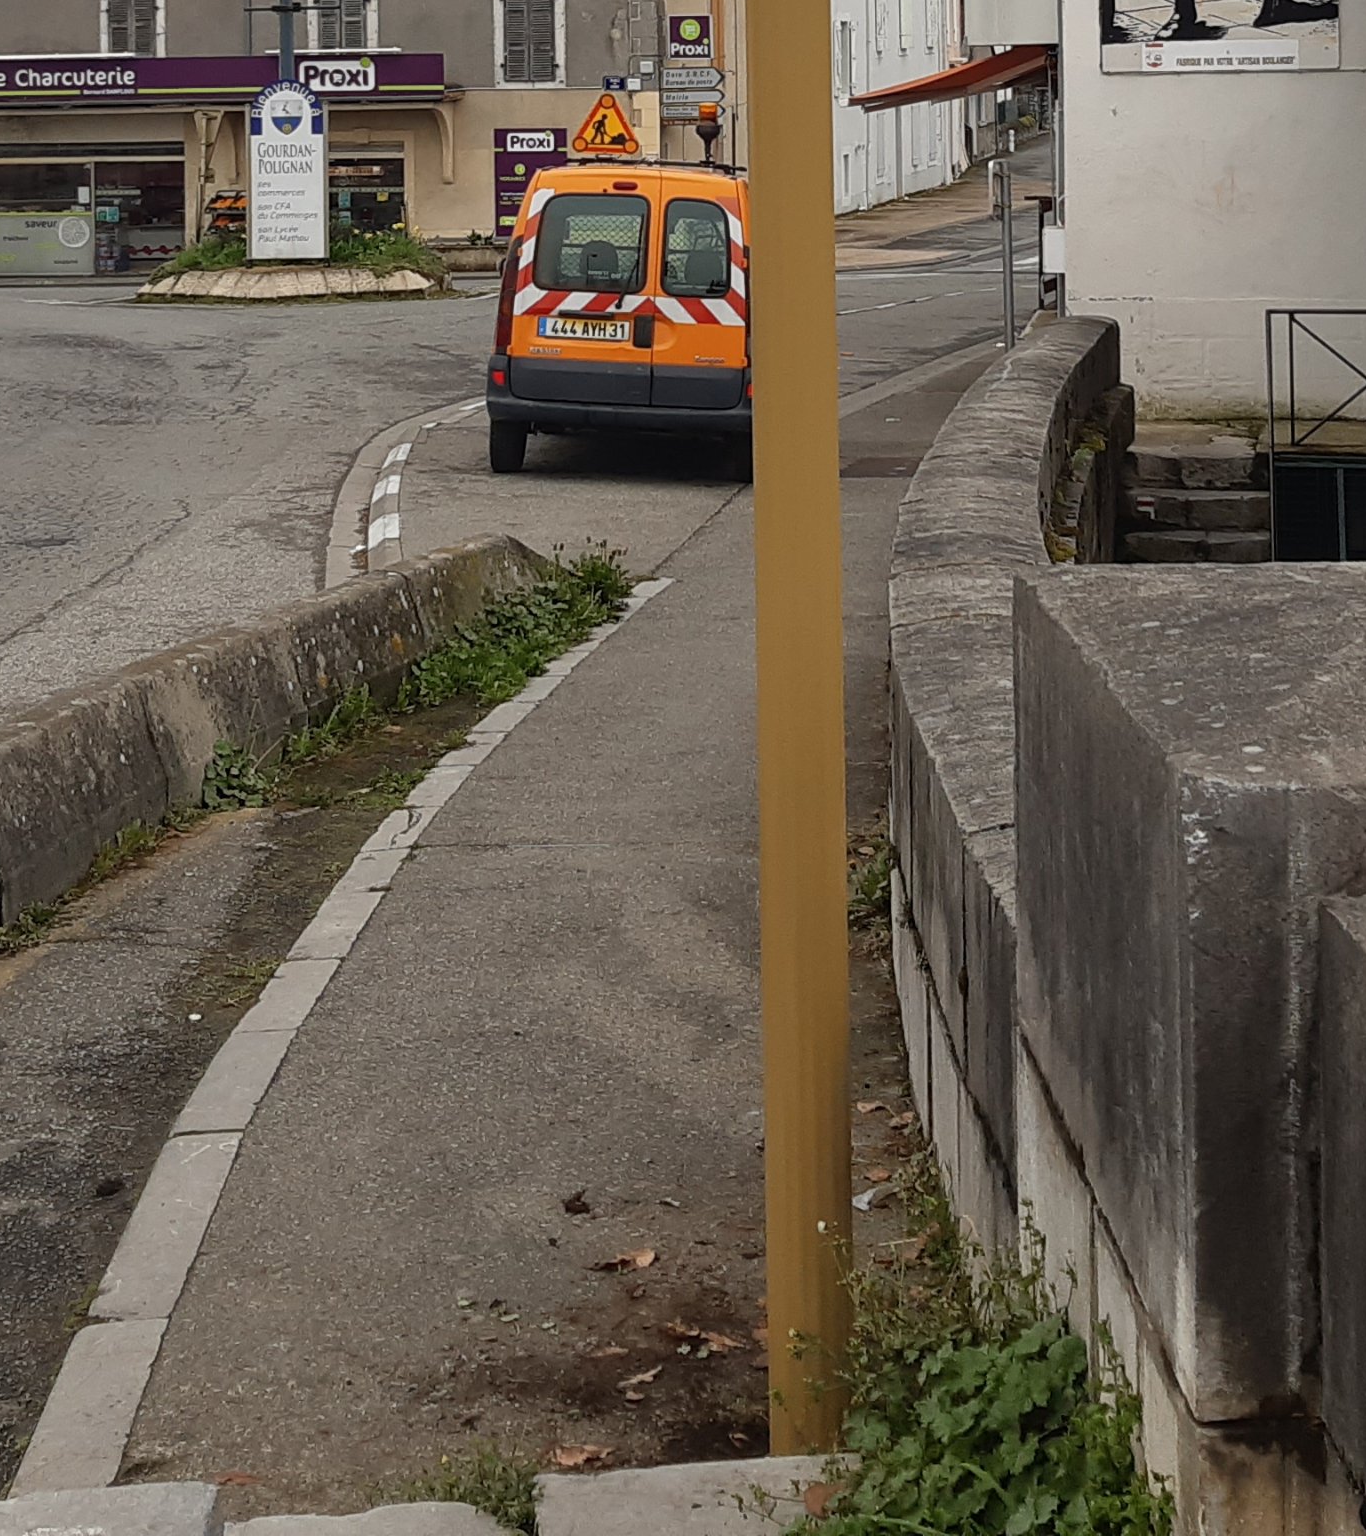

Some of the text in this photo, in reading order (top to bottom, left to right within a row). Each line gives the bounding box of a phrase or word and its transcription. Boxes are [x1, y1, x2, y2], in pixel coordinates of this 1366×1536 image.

[670, 37, 709, 56] Proxi
[14, 66, 136, 88] Charcuterie
[304, 57, 370, 87] Proxi
[251, 81, 316, 117] Bienvenue
[510, 131, 552, 149] Proxi
[257, 142, 317, 158] GOURDAN-
[258, 159, 313, 175] POLIGNAN
[257, 189, 306, 197] commerces
[274, 202, 291, 211] CFA
[25, 220, 58, 229] saveur
[551, 320, 625, 339] 444 AYH 31
